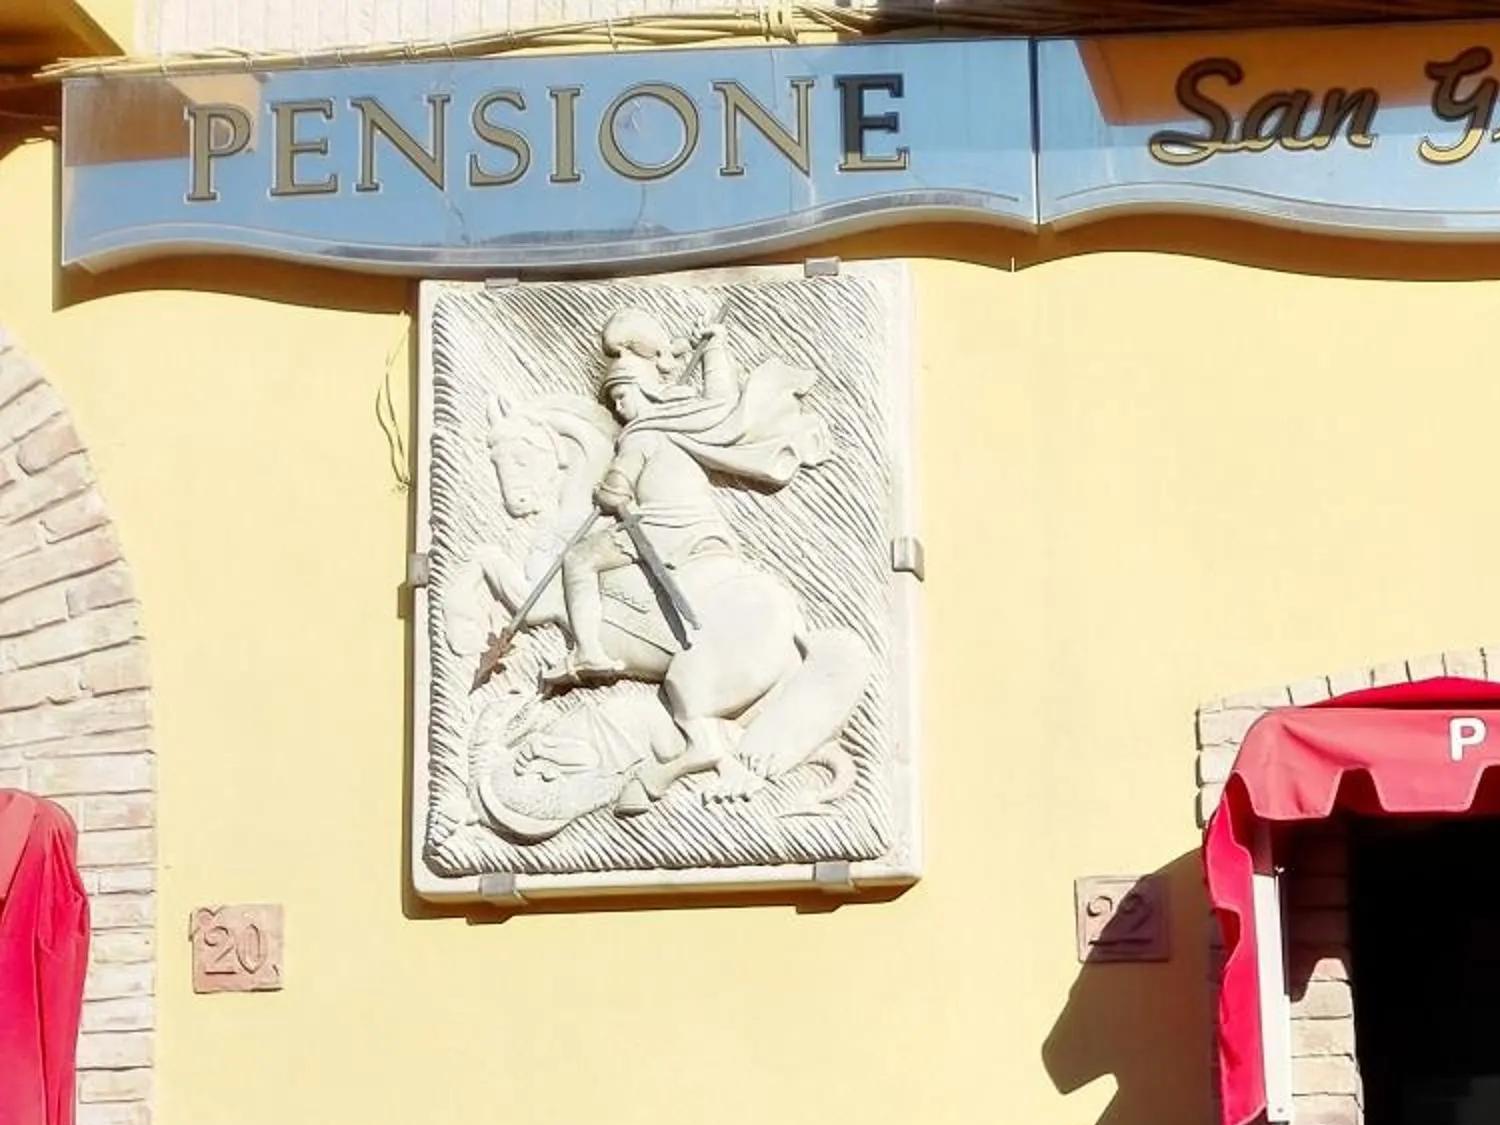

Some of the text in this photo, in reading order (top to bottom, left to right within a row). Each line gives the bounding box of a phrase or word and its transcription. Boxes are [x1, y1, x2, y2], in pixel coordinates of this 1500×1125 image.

[183, 73, 911, 203] PENSIONE
[1148, 56, 1379, 166] San
[202, 922, 268, 976] 20
